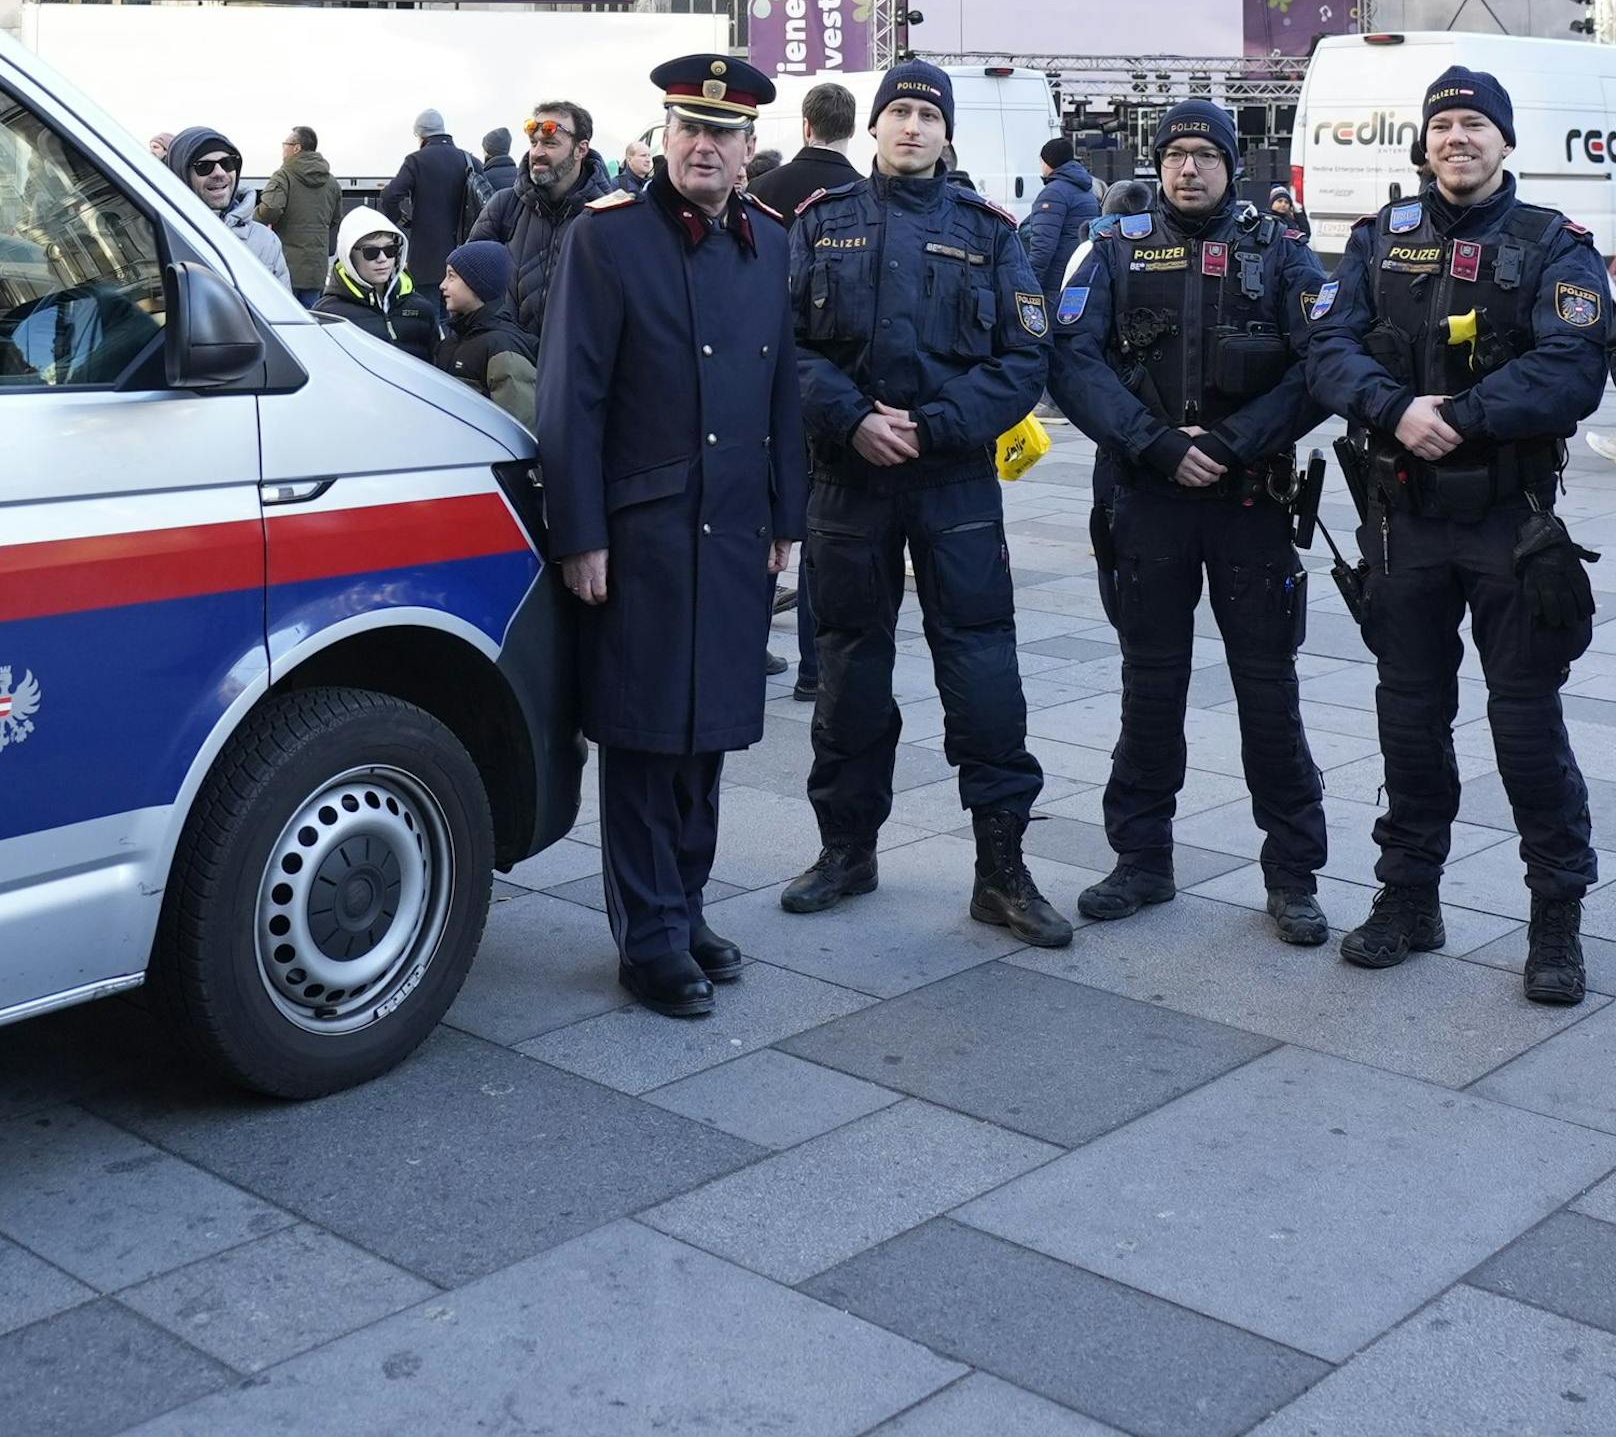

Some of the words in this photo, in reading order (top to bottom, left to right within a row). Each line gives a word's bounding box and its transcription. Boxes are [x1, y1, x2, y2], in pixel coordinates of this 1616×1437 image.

[896, 82, 931, 93] POLIZEI
[1170, 122, 1210, 133] POLIZEI
[1314, 111, 1419, 145] redlin
[1134, 246, 1185, 261] POLIZEI
[1389, 246, 1441, 261] POLIZEI
[1560, 285, 1597, 303] POLIZEI
